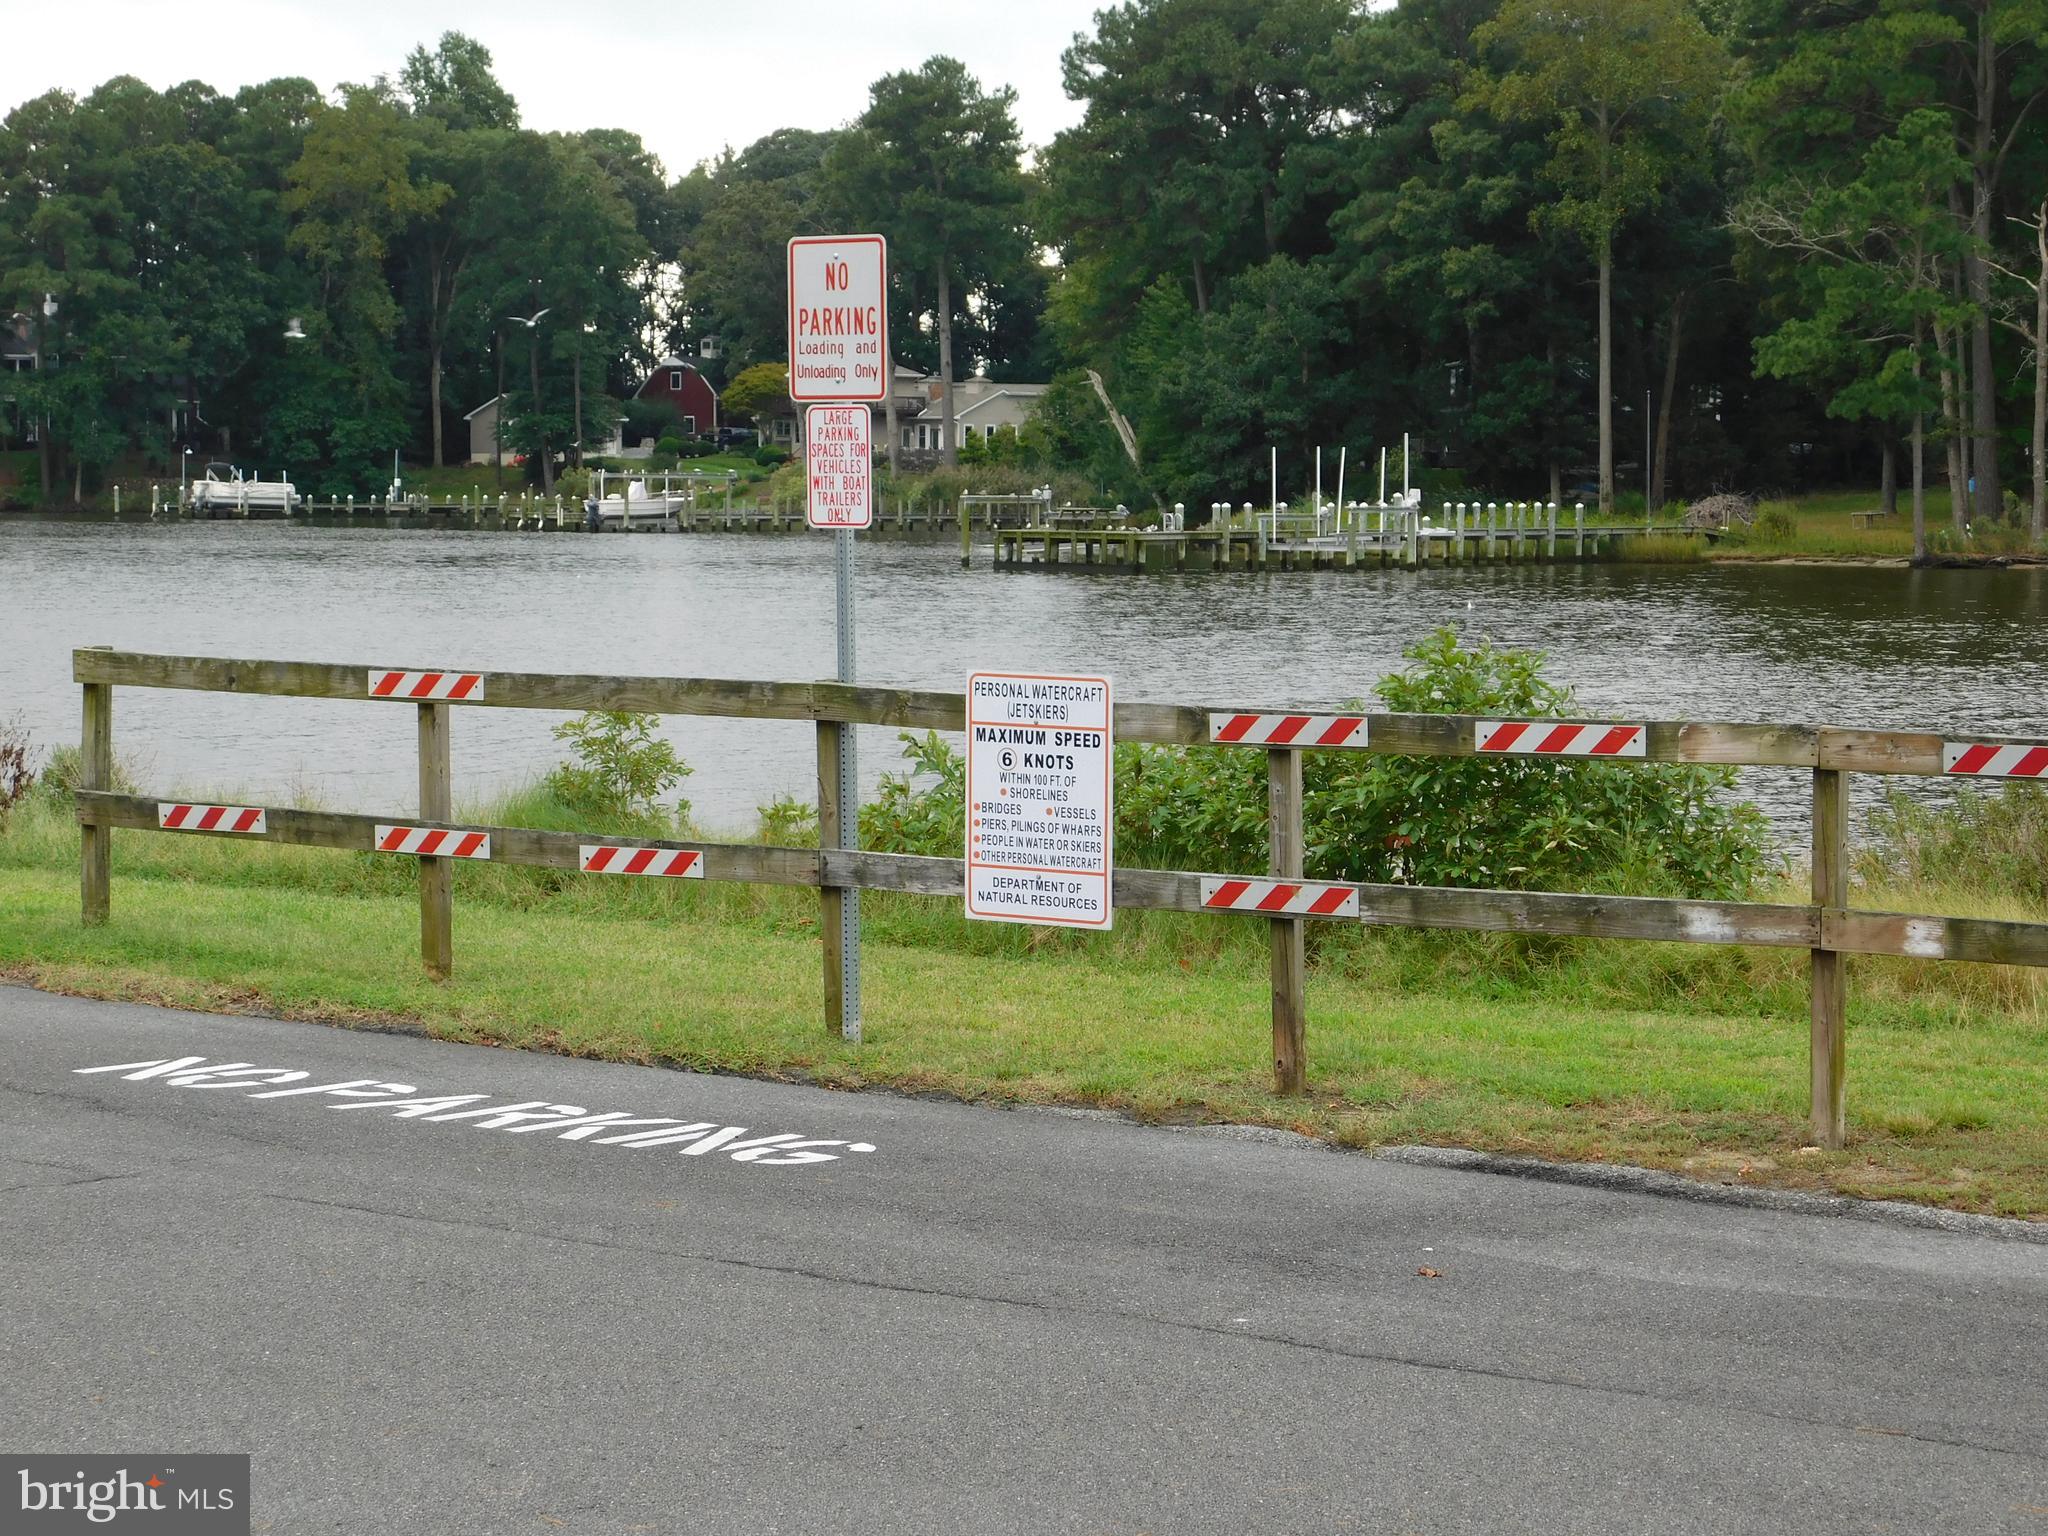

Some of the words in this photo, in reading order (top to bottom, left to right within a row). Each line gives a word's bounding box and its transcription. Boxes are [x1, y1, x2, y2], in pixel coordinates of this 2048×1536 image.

[825, 262, 849, 291] NO
[799, 307, 876, 336] PARKING
[799, 340, 844, 359] Loading
[855, 340, 877, 354] and
[797, 364, 846, 382] Unloading
[855, 363, 878, 382] Only
[823, 410, 853, 425] LARGE
[818, 427, 859, 441] PARKING
[811, 443, 845, 457] SPACES
[850, 443, 866, 457] FOR
[817, 459, 861, 474] VEHICLES
[813, 476, 835, 490] WITH
[843, 476, 866, 490] BOAT
[817, 492, 862, 506] TRAILERS
[827, 508, 852, 522] ONLY
[974, 681, 1030, 699] PERSONAL
[1032, 685, 1103, 702] WATERCRAFT
[1007, 701, 1069, 722] (JETSKIERS)
[976, 727, 1046, 746] MAXIMUM
[1054, 731, 1101, 748] SPEED
[1001, 752, 1013, 767] 6
[1024, 753, 1074, 770] KNOTS
[1000, 772, 1031, 785] WITHIN
[1034, 774, 1048, 786] 100
[1050, 775, 1062, 787] FT.
[1064, 776, 1077, 787] OF
[1010, 787, 1068, 801] SHORELINES
[981, 802, 1022, 815] BRIDGES
[1054, 807, 1096, 820] VESSELS
[981, 818, 1009, 832] PIERS,
[1011, 820, 1045, 834] PILINGS
[1047, 823, 1060, 834] OF
[1062, 824, 1102, 837] WHARFS
[981, 834, 1014, 847] PEOPLE
[1015, 836, 1025, 848] IN
[1026, 837, 1055, 850] WATER
[1056, 839, 1069, 851] OR
[1070, 840, 1102, 854] SKIERS
[981, 850, 1006, 862] OTHER
[1007, 852, 1048, 866] PERSONAL
[1050, 855, 1102, 869] WATERCRAFT
[992, 876, 1065, 893] DEPARTMENT
[1067, 883, 1083, 894] OF
[978, 891, 1028, 905] NATURAL
[1031, 895, 1098, 910] RESOURCES
[72, 1056, 311, 1088] NO
[247, 1079, 877, 1165] PARKING
